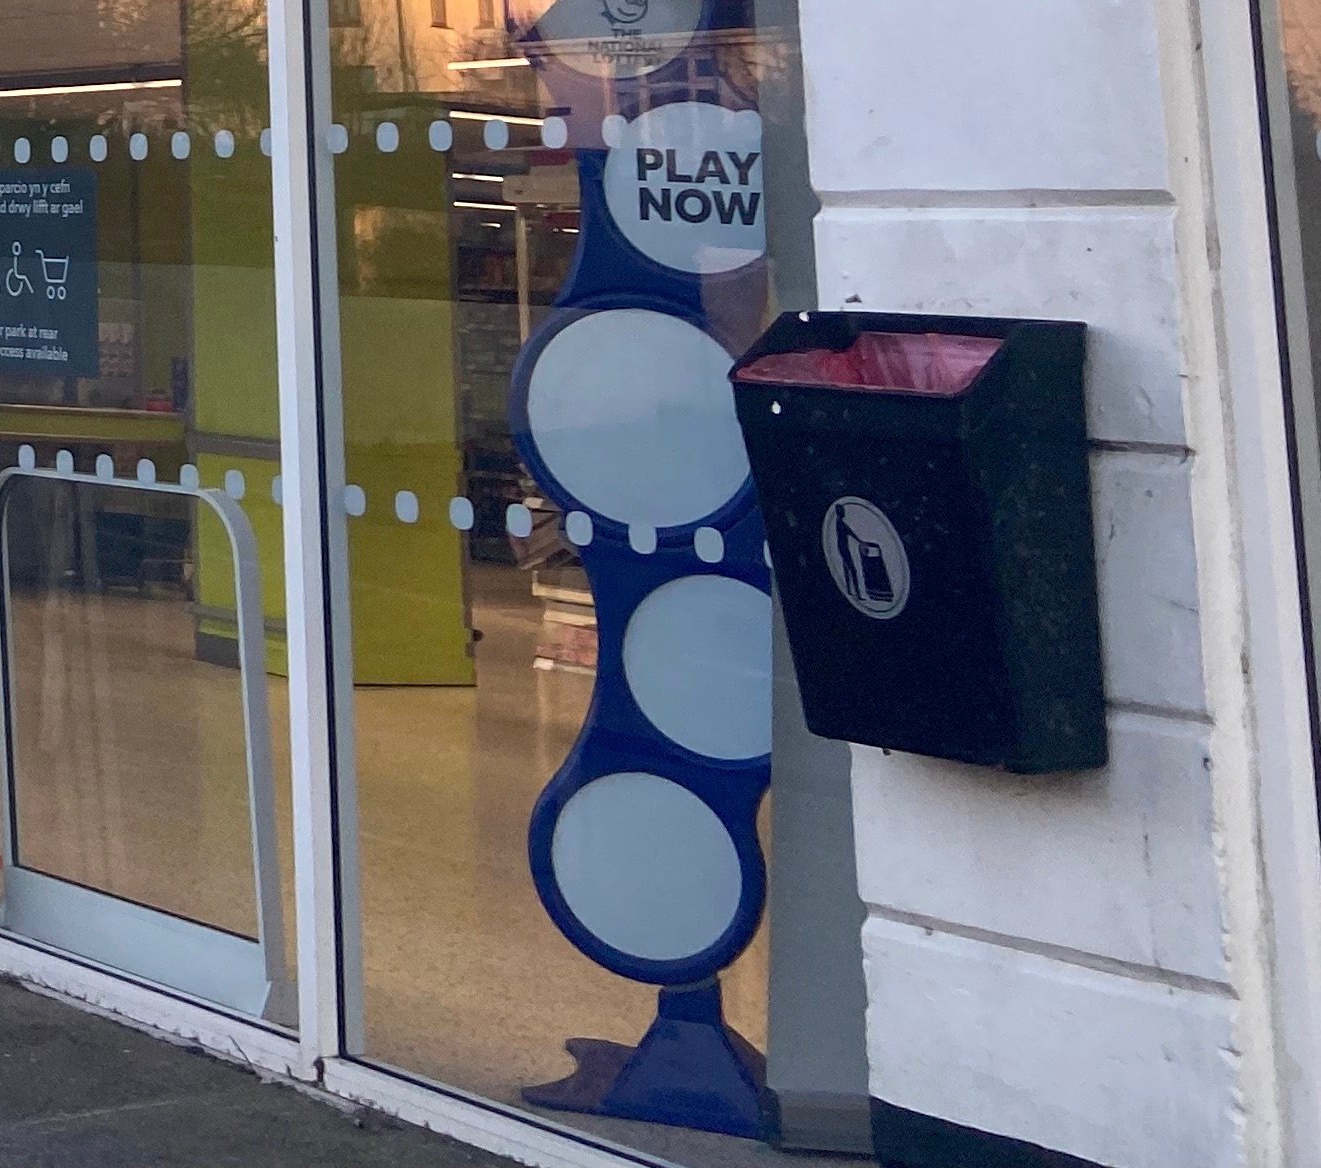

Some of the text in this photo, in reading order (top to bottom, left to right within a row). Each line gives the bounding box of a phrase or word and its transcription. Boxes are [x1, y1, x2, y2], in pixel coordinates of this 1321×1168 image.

[611, 28, 642, 38] THE
[588, 38, 662, 52] NATIONAL
[636, 147, 761, 186] PLAY
[0, 180, 27, 198] parcio
[28, 183, 41, 198] yn
[50, 178, 71, 193] cefn
[8, 200, 31, 217] drwy
[50, 203, 61, 213] ar
[62, 199, 84, 217] gael
[638, 186, 761, 226] NOW
[4, 323, 27, 340] park
[28, 326, 38, 338] at
[39, 329, 58, 340] rear
[25, 344, 68, 362] available
